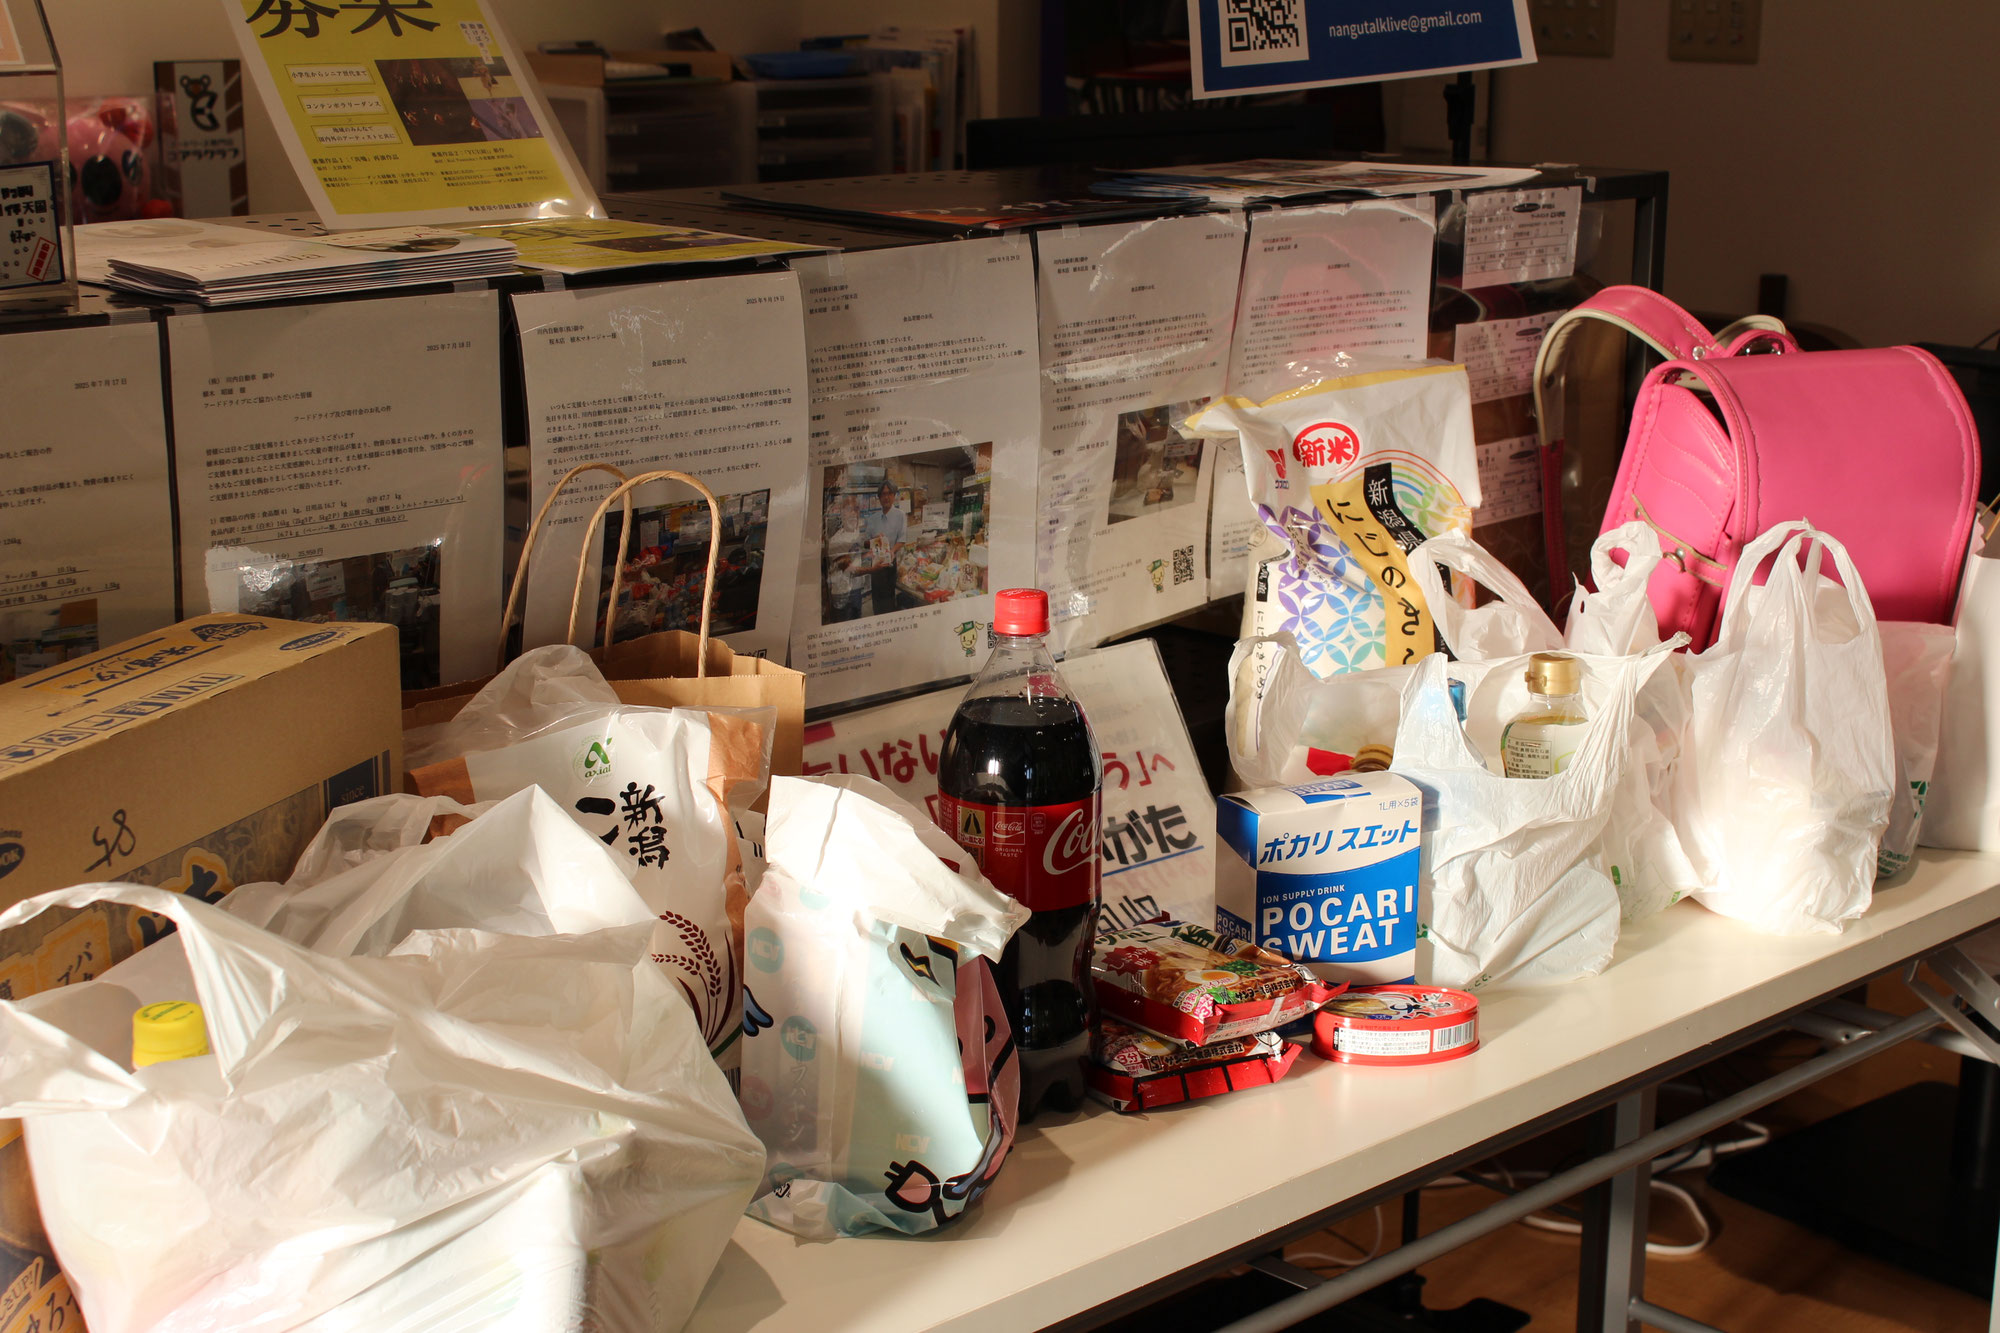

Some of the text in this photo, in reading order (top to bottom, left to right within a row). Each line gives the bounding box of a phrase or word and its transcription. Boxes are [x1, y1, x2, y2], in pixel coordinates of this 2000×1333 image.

[1328, 10, 1483, 39] nangutalklive@gmail.com
[1301, 435, 1352, 468] 新米
[585, 764, 612, 778] axial
[619, 781, 671, 870] 新潟
[1260, 819, 1418, 865] ポカリ スエット
[1262, 885, 1415, 936] POCARI
[1263, 884, 1346, 904] ION SUPPLY DRINK
[1216, 914, 1252, 942] POCARI
[1262, 917, 1400, 961] SWEAT
